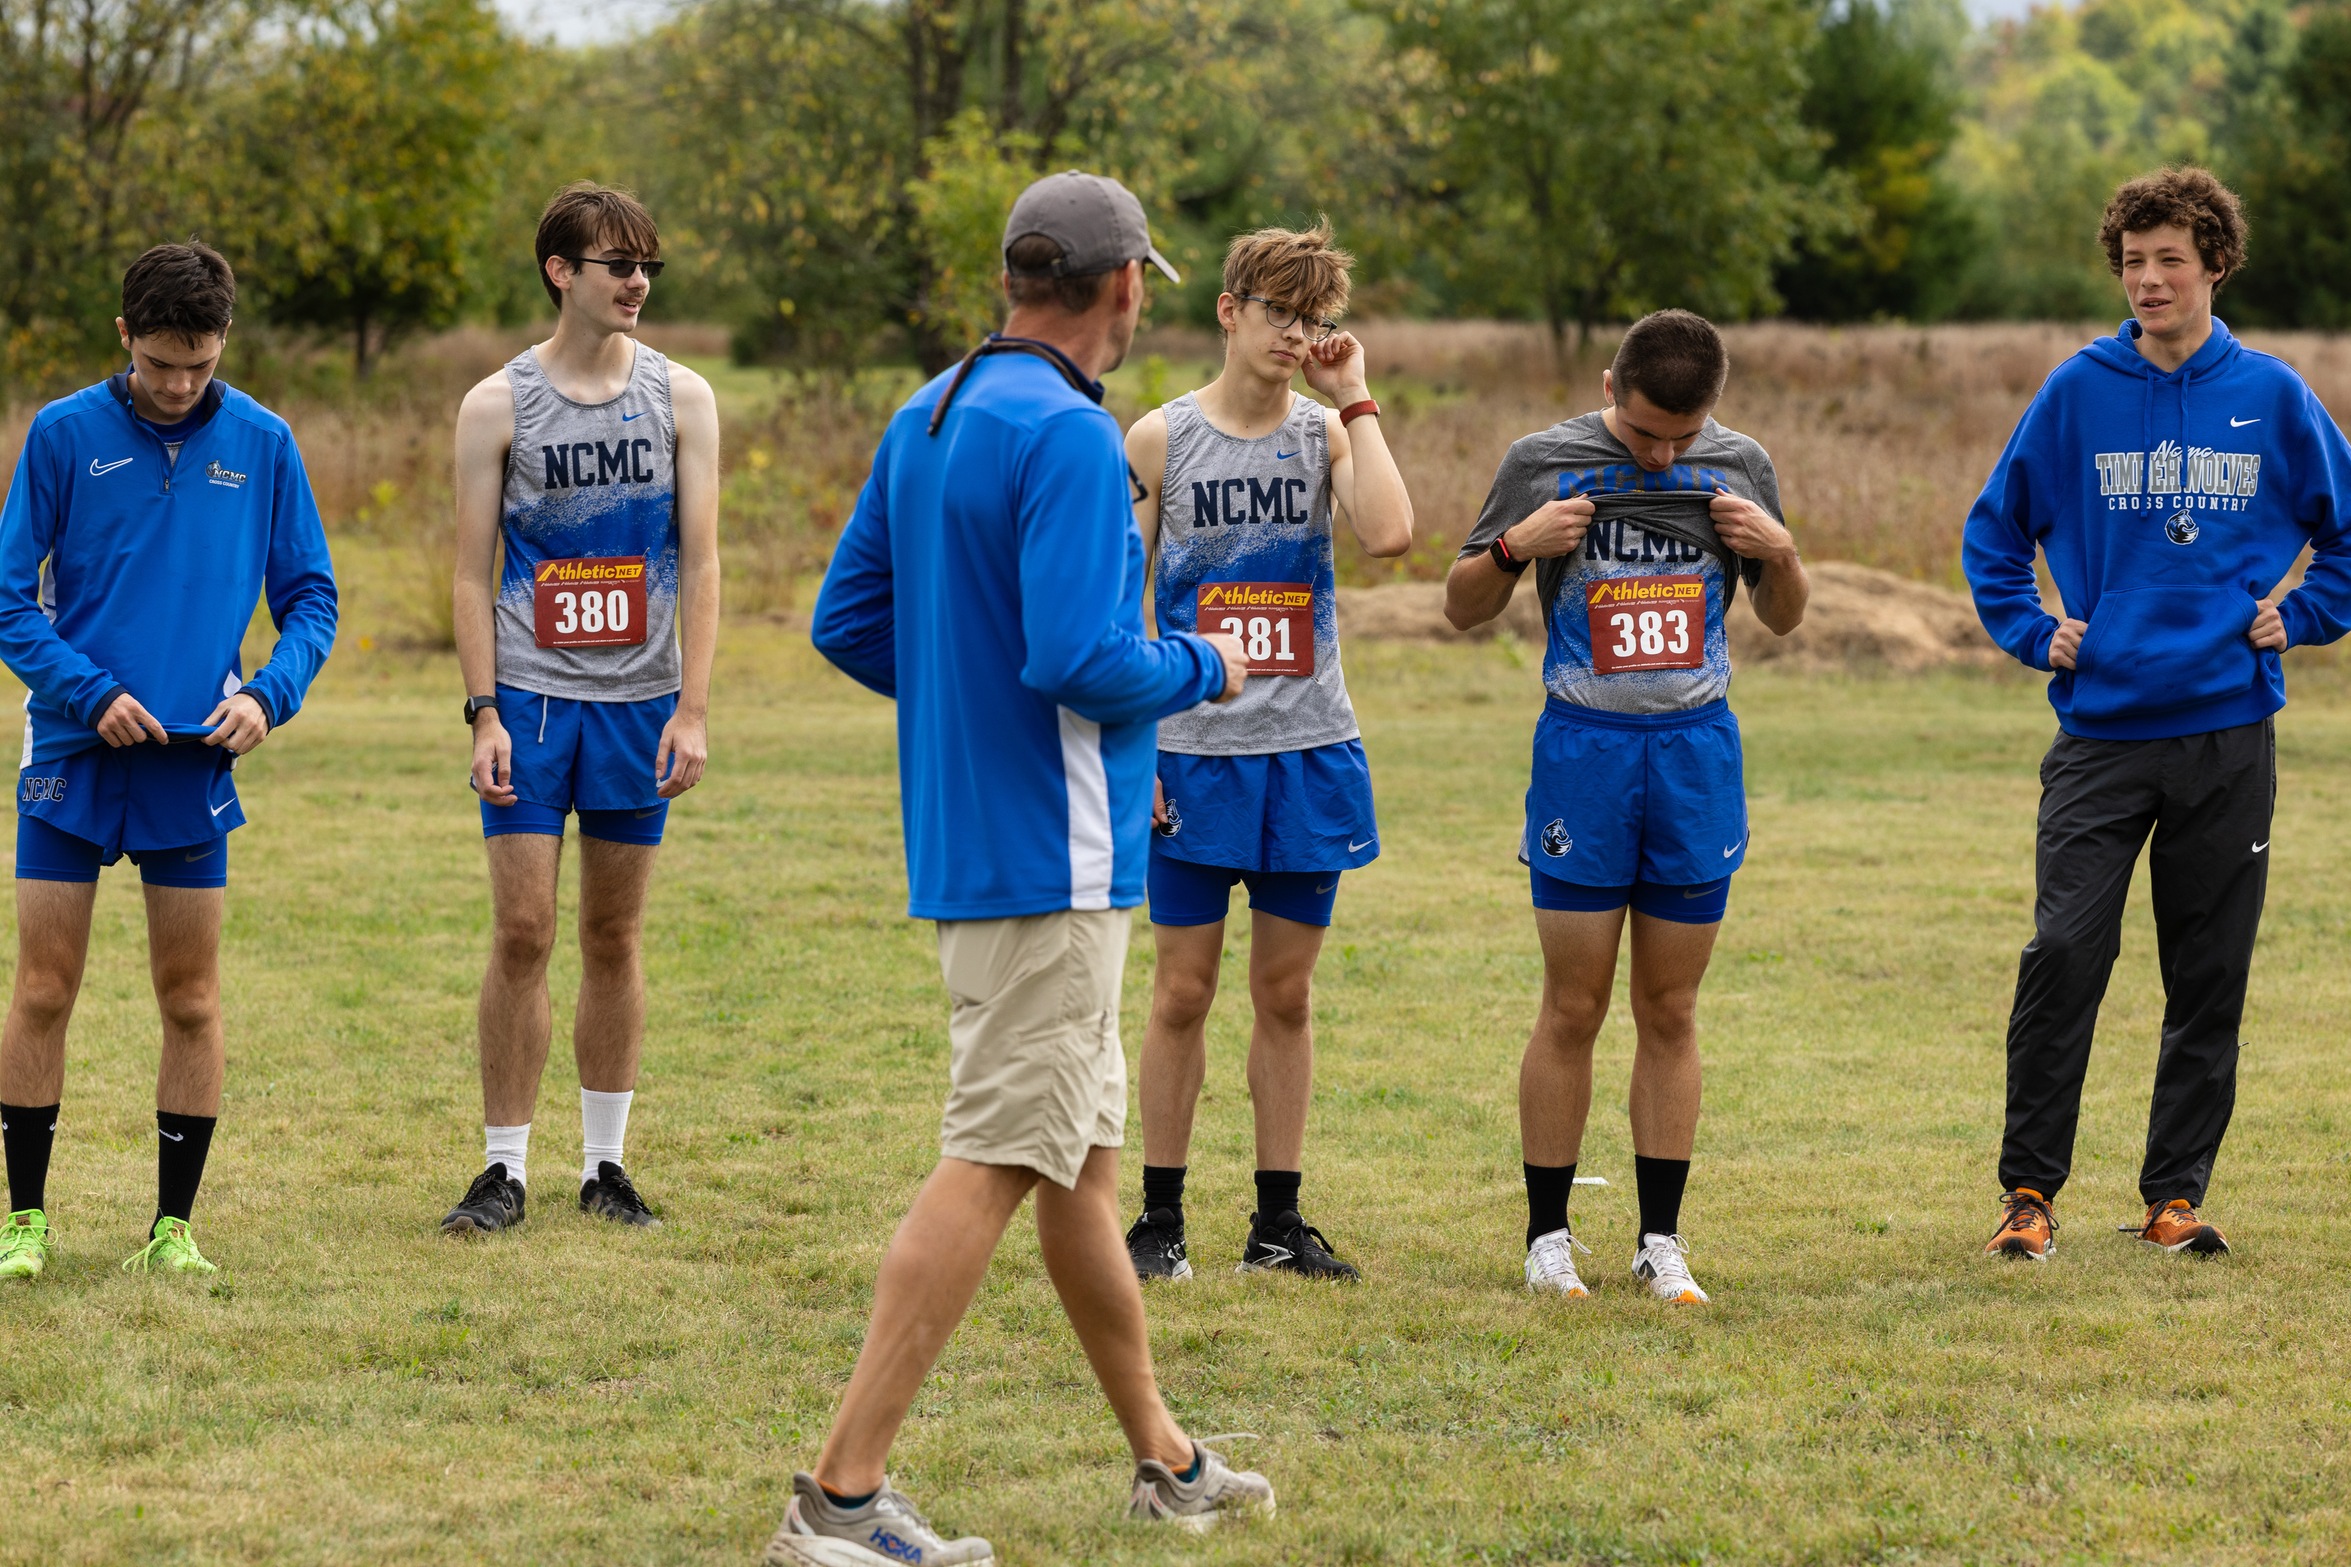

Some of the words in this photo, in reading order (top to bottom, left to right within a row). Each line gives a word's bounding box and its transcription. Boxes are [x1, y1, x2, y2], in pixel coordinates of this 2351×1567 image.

[208, 478, 223, 486] CROSS
[222, 480, 240, 489] COUNTRY
[213, 468, 247, 483] NCMC
[542, 438, 654, 490] NCMC
[1192, 477, 1308, 528] NCMC
[2172, 495, 2248, 512] COUNTRY
[554, 589, 630, 634] 380
[1610, 609, 1690, 658] 383
[869, 1526, 923, 1565] HOKA
